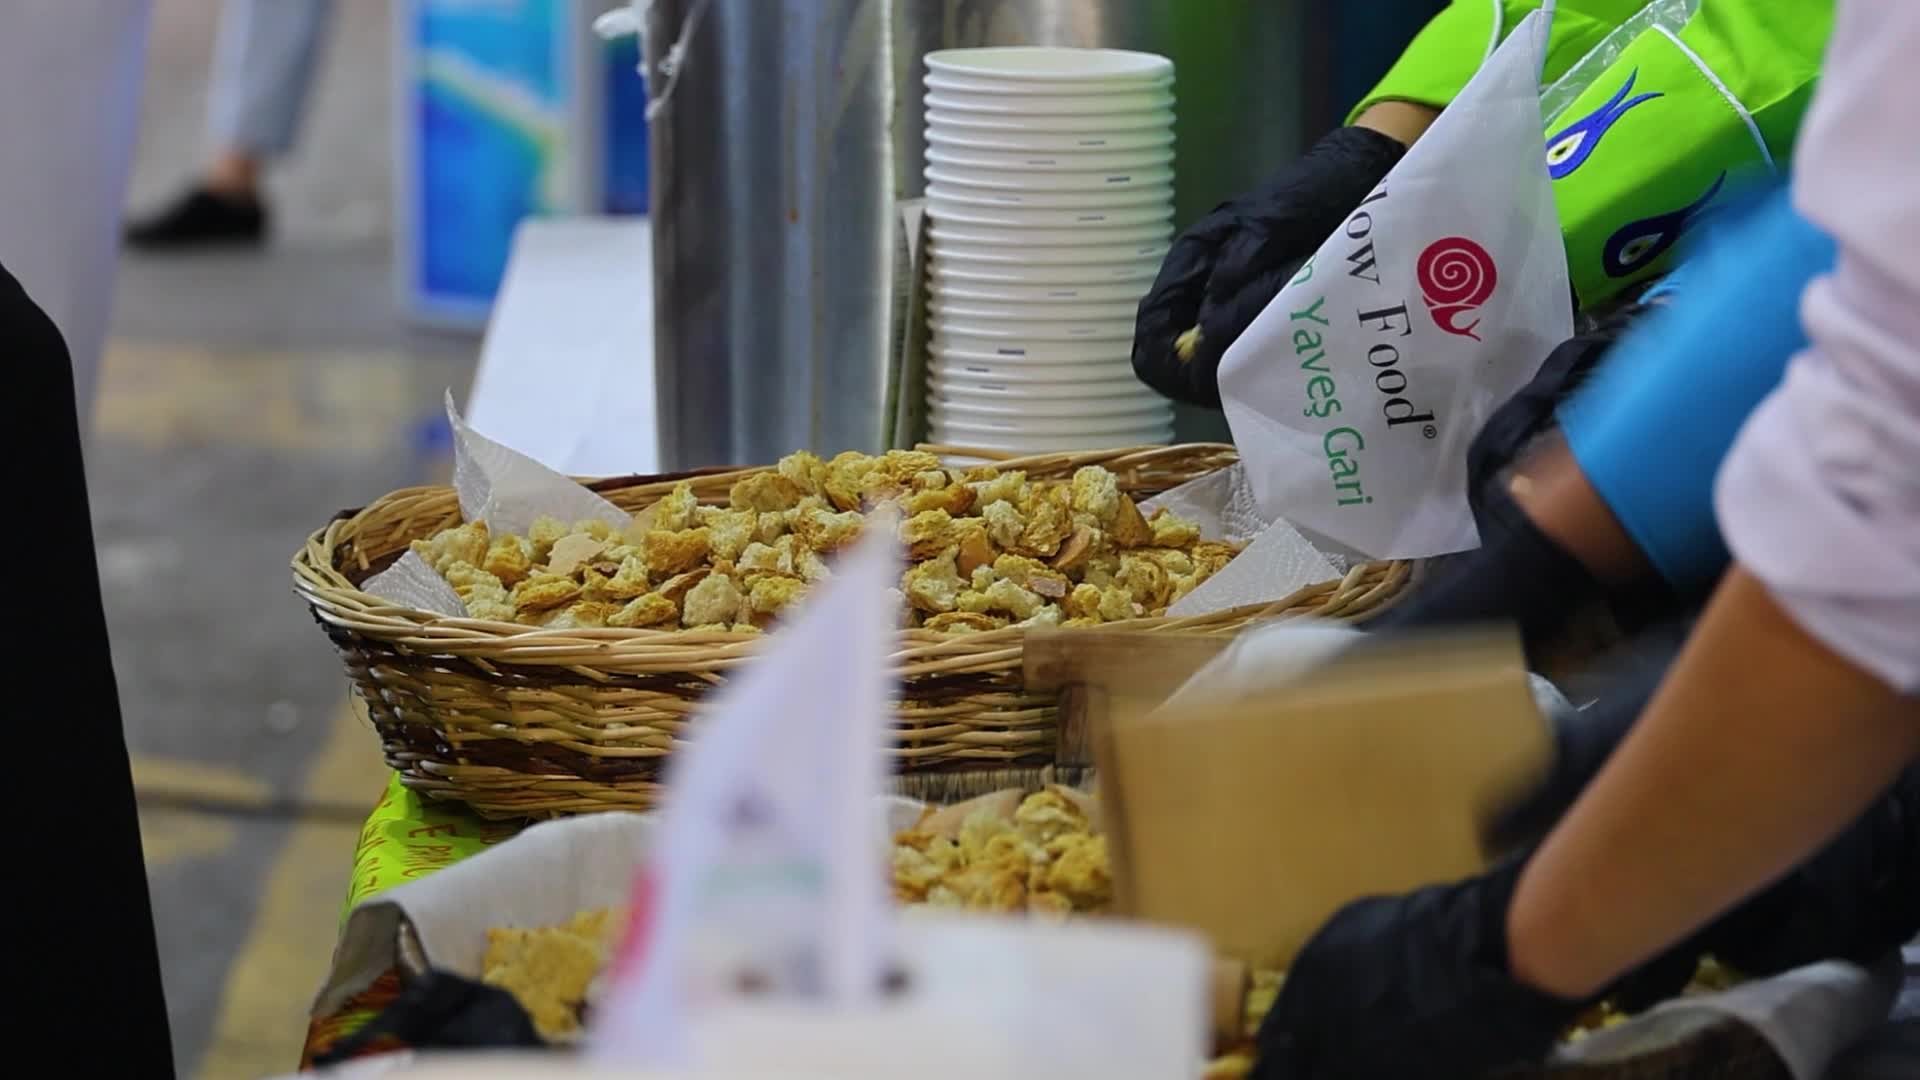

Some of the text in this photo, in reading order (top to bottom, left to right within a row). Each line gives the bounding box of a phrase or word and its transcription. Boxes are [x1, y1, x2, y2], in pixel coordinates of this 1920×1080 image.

[1346, 180, 1388, 285] low
[1290, 296, 1342, 418] Yaveş
[1323, 427, 1373, 507] Gari
